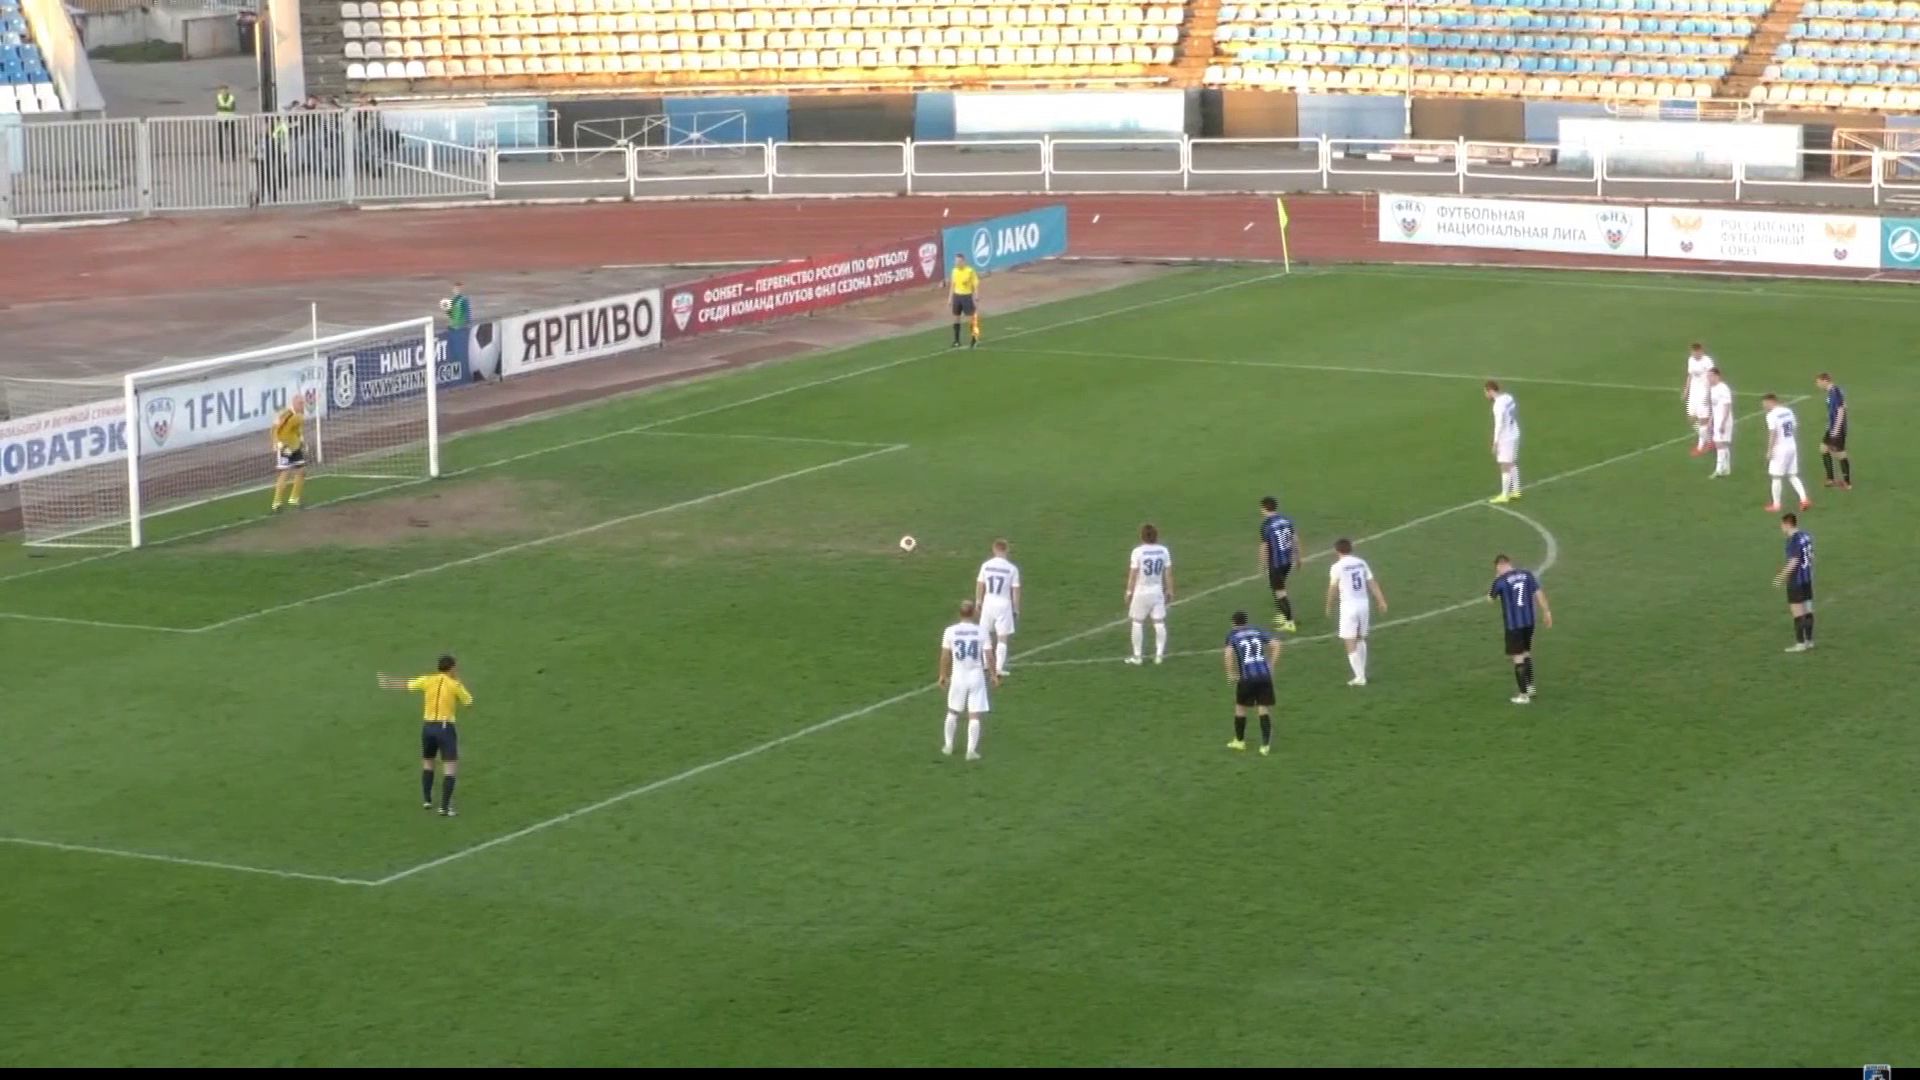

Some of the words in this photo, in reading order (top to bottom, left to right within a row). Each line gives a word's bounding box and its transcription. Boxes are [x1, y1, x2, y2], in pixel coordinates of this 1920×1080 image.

[1437, 206, 1525, 221] ФУТБОЛЬНАЯ
[996, 223, 1040, 257] JAKO
[1437, 222, 1549, 240] НАЦИОНАЛЬНАЯ
[1552, 227, 1587, 241] ЛИГА
[704, 283, 744, 304] ФОНБЕТ
[755, 270, 814, 293] ПЕРВЕНСТВО
[815, 261, 851, 280] РОССИИ
[851, 259, 865, 273] ПО
[866, 250, 909, 270] ФУТБОЛУ
[698, 303, 730, 323] СРЕДИ
[731, 294, 774, 316] КОМАНД
[775, 287, 814, 307] КЛУБОВ
[815, 281, 836, 299] ФНЛ
[838, 275, 872, 294] СЕЗОНА
[873, 266, 915, 287] 2015-2016
[521, 298, 653, 362] ЯРПИВО
[380, 347, 411, 374] НАШ
[415, 337, 448, 366] СЙТ
[184, 386, 288, 432] 1FNL.ru
[0, 420, 127, 477] ОВАТЭК
[1143, 558, 1164, 576] 30
[988, 575, 1005, 595] 17
[1351, 570, 1362, 592] 5
[1512, 581, 1525, 607] 7
[954, 639, 979, 661] 34
[1239, 637, 1265, 664] 22
